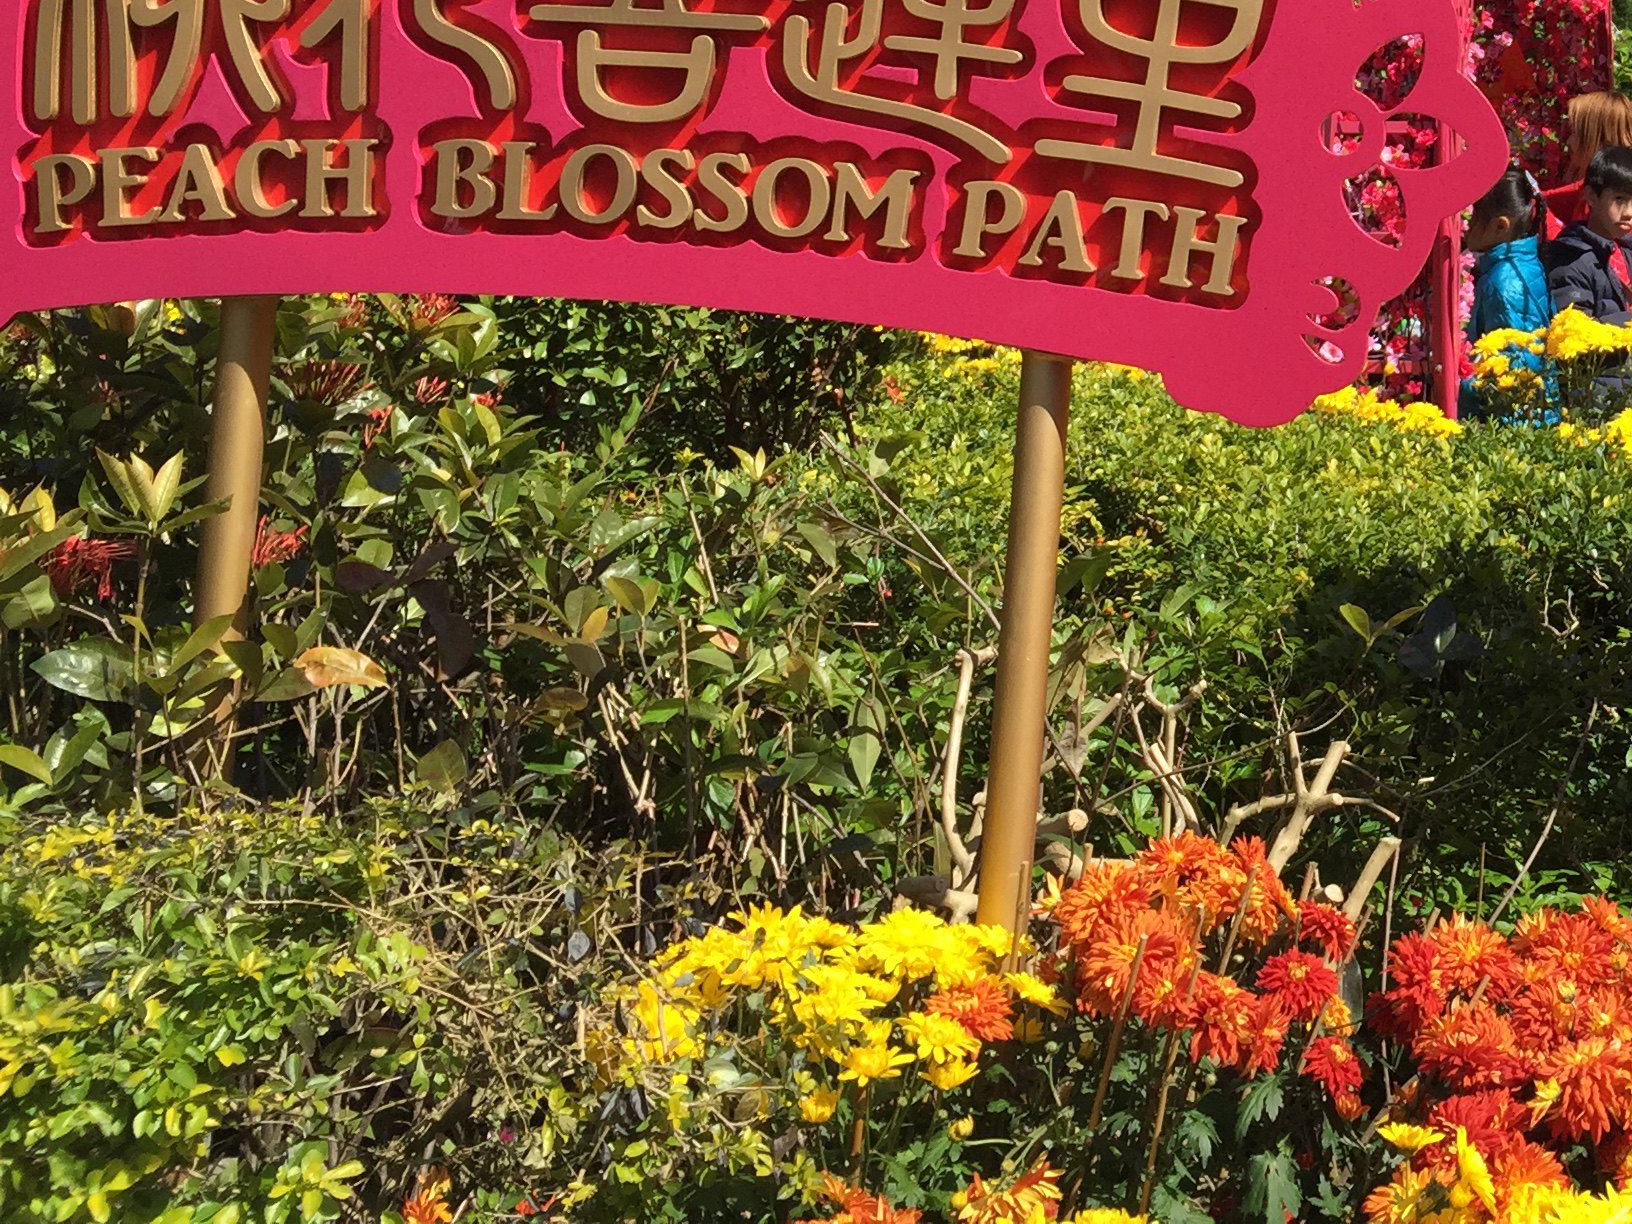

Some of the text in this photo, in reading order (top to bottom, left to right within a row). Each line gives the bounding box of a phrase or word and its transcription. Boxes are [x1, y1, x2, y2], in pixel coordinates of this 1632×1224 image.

[32, 137, 1250, 296] PEACH BLOSSOM PATH
